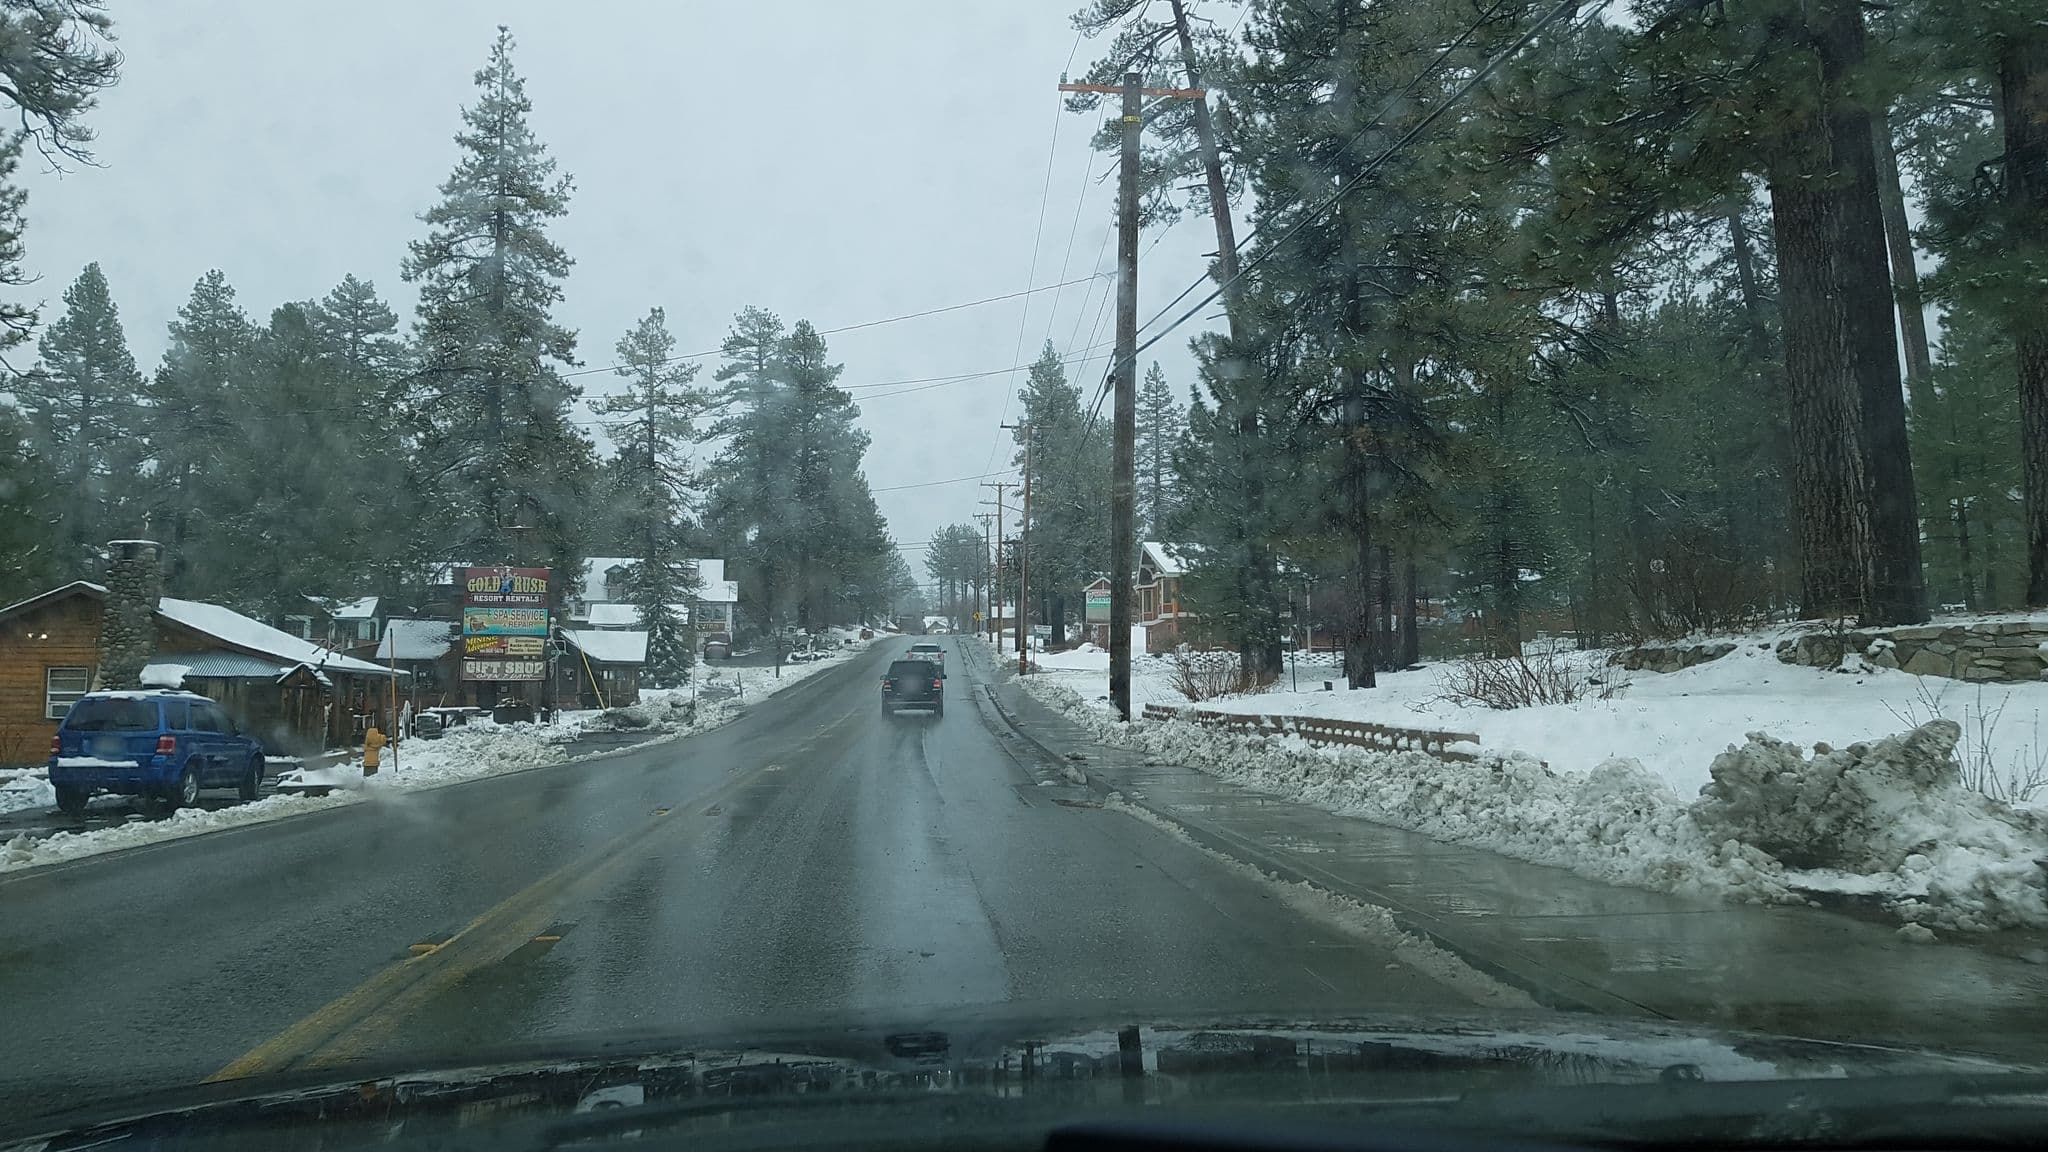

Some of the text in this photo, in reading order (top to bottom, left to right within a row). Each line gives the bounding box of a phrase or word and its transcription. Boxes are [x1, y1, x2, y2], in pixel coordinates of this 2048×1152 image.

[467, 576, 547, 592] GOLD RUSH
[493, 609, 544, 620] SPA SERVICE
[465, 636, 498, 648] MINING
[466, 661, 544, 674] GIFT SHOP
